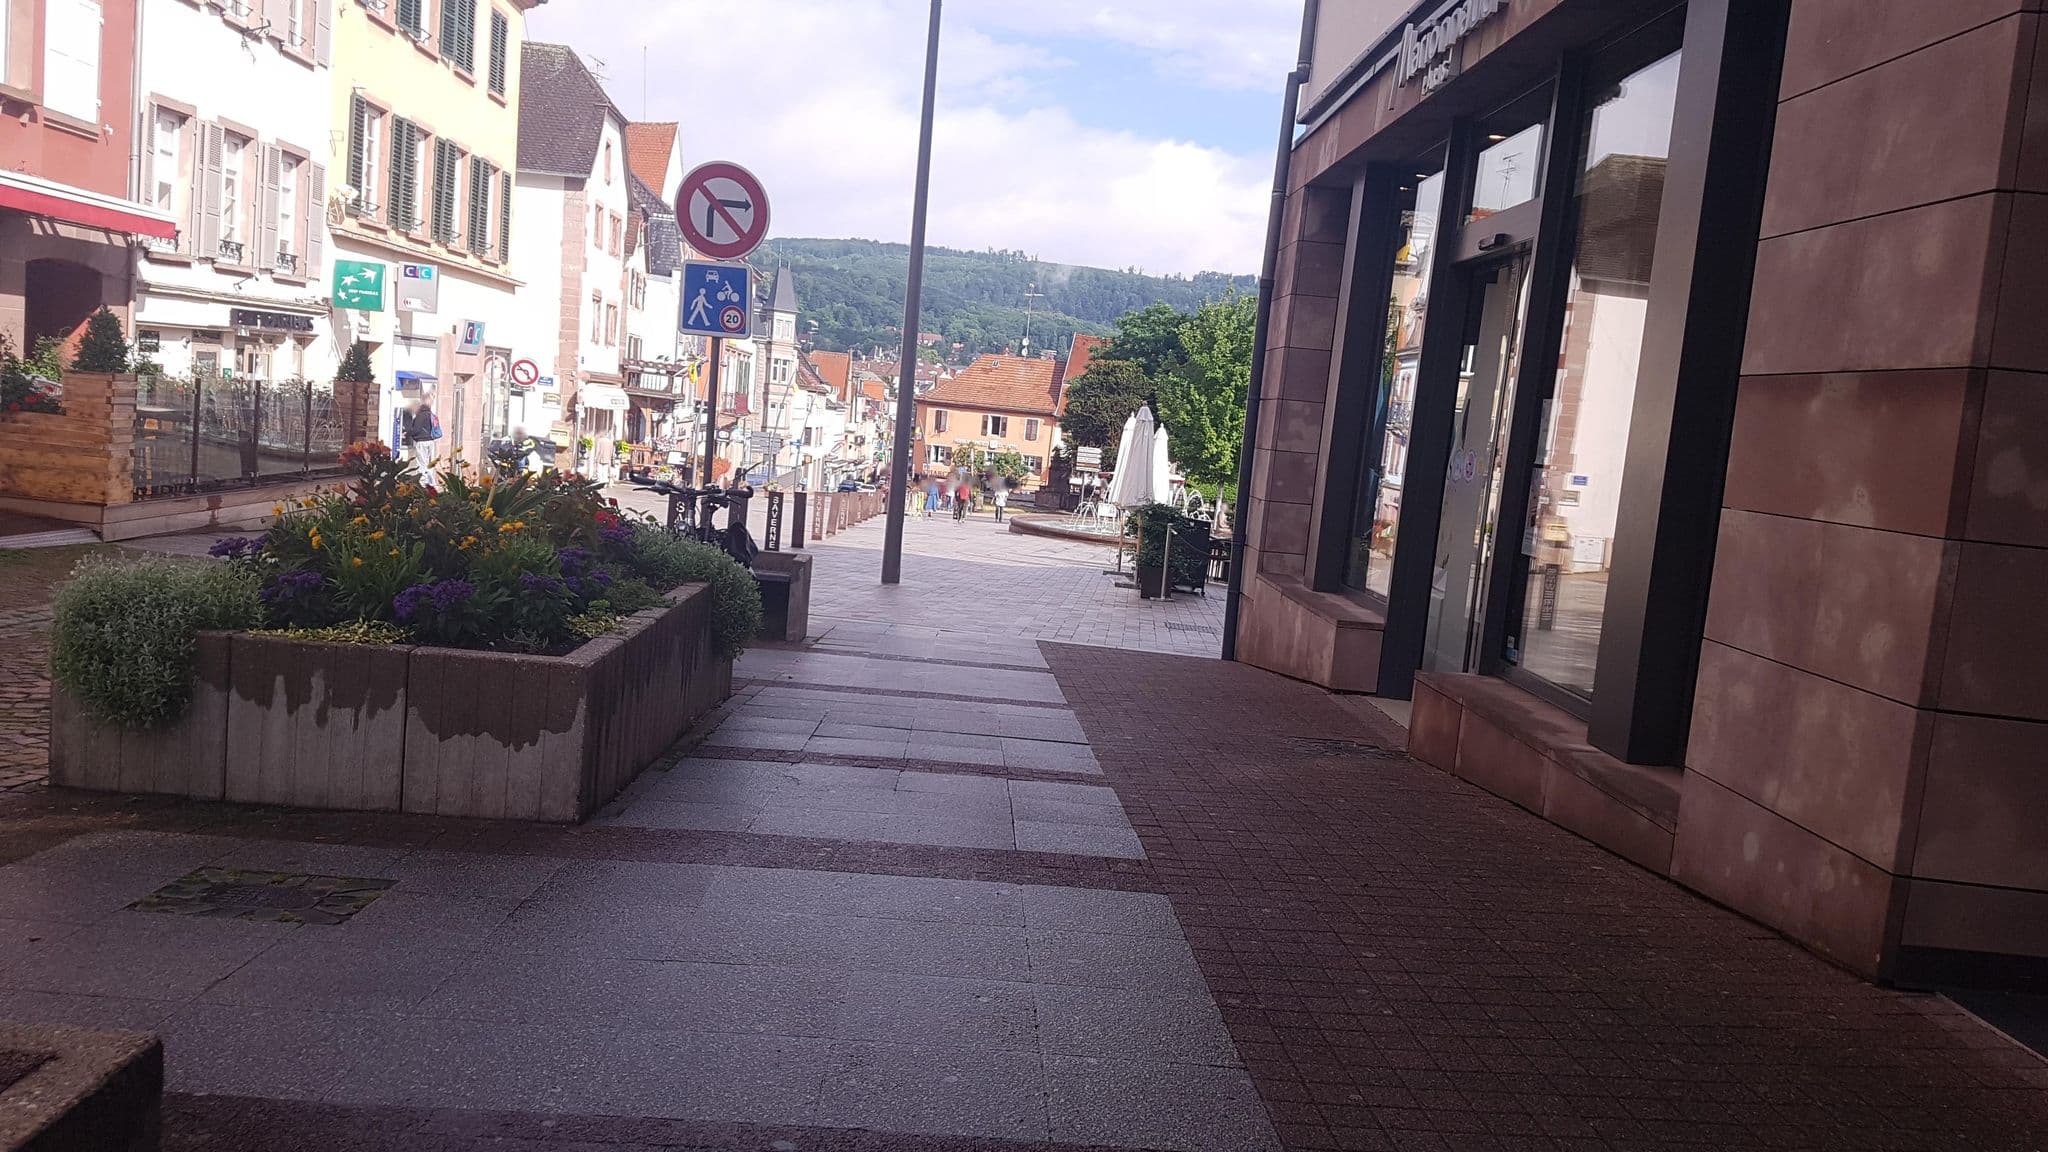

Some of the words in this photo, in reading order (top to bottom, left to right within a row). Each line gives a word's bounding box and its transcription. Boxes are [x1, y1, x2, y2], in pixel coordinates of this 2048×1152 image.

[404, 265, 431, 278] CIC
[726, 315, 739, 323] 20
[769, 496, 779, 549] SAVERNE
